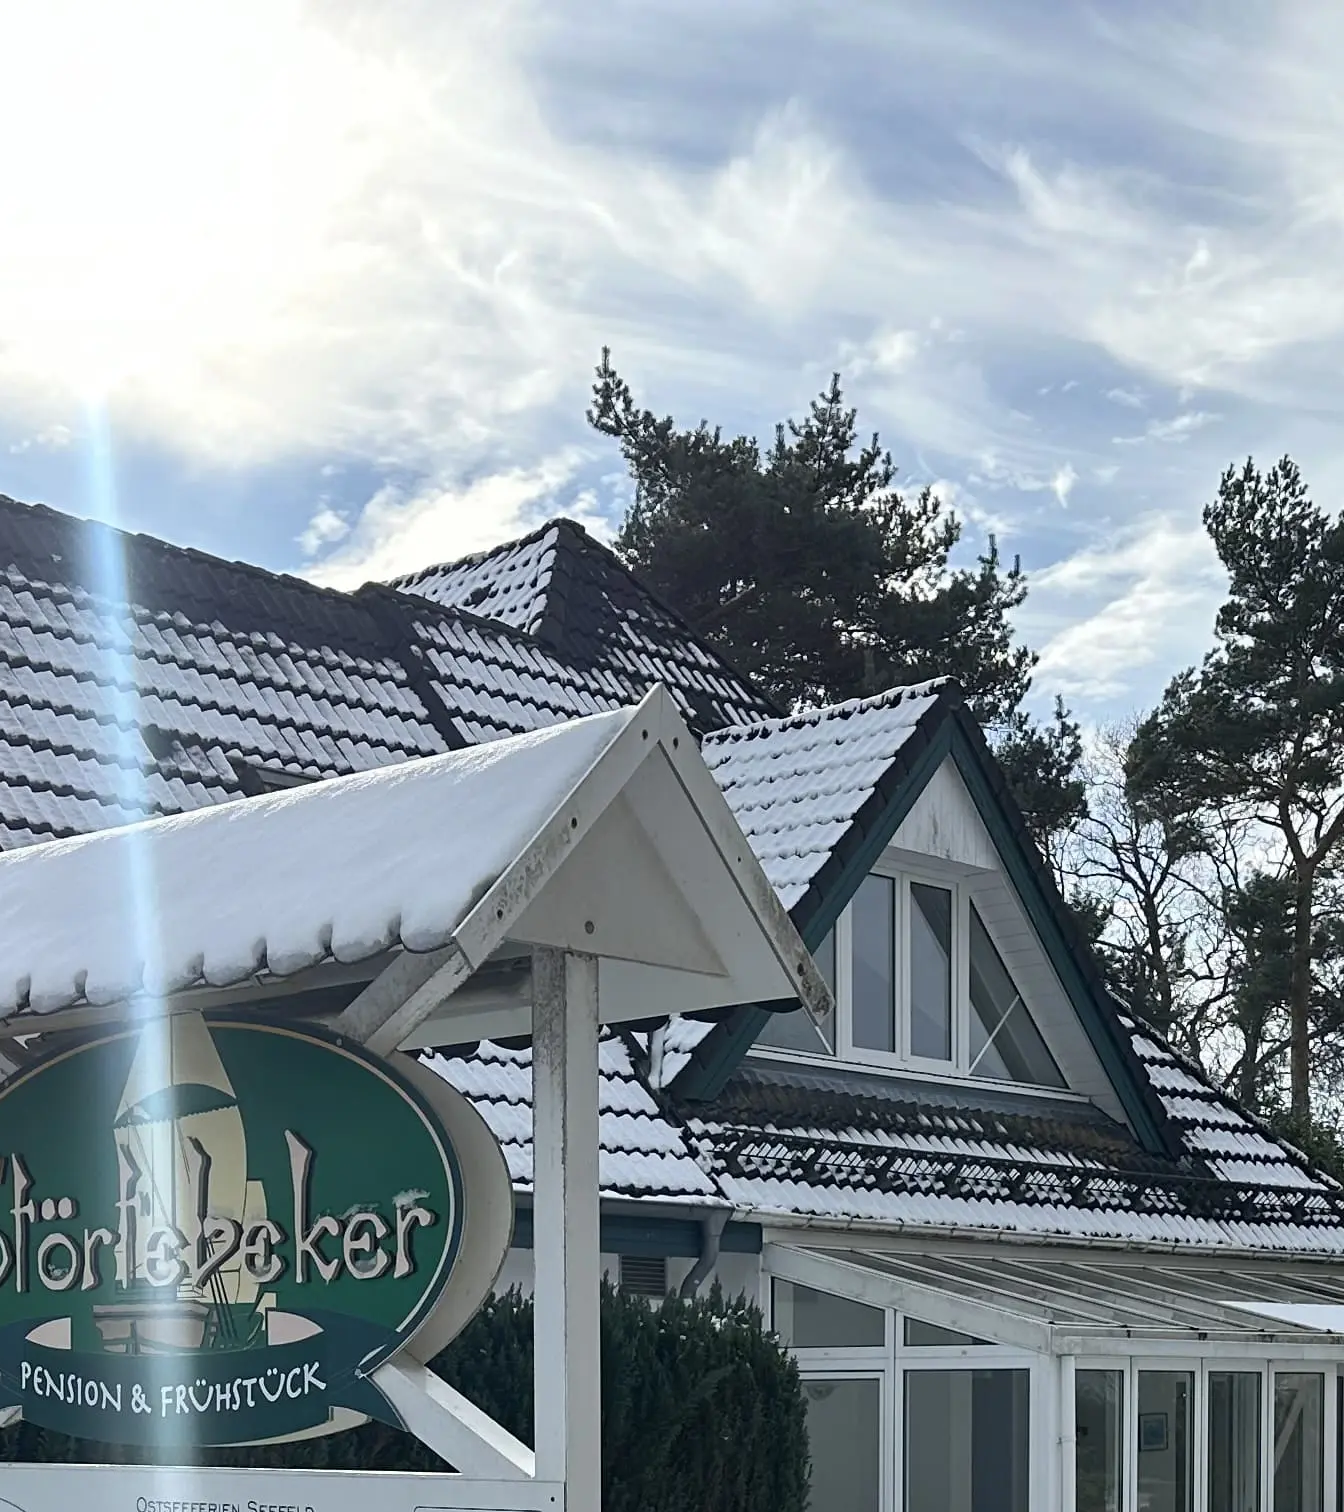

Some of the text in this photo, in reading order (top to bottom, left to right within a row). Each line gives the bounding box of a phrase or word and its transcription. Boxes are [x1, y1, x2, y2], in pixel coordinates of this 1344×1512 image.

[20, 1360, 327, 1418] PENSION & FRÜHSTÜCK
